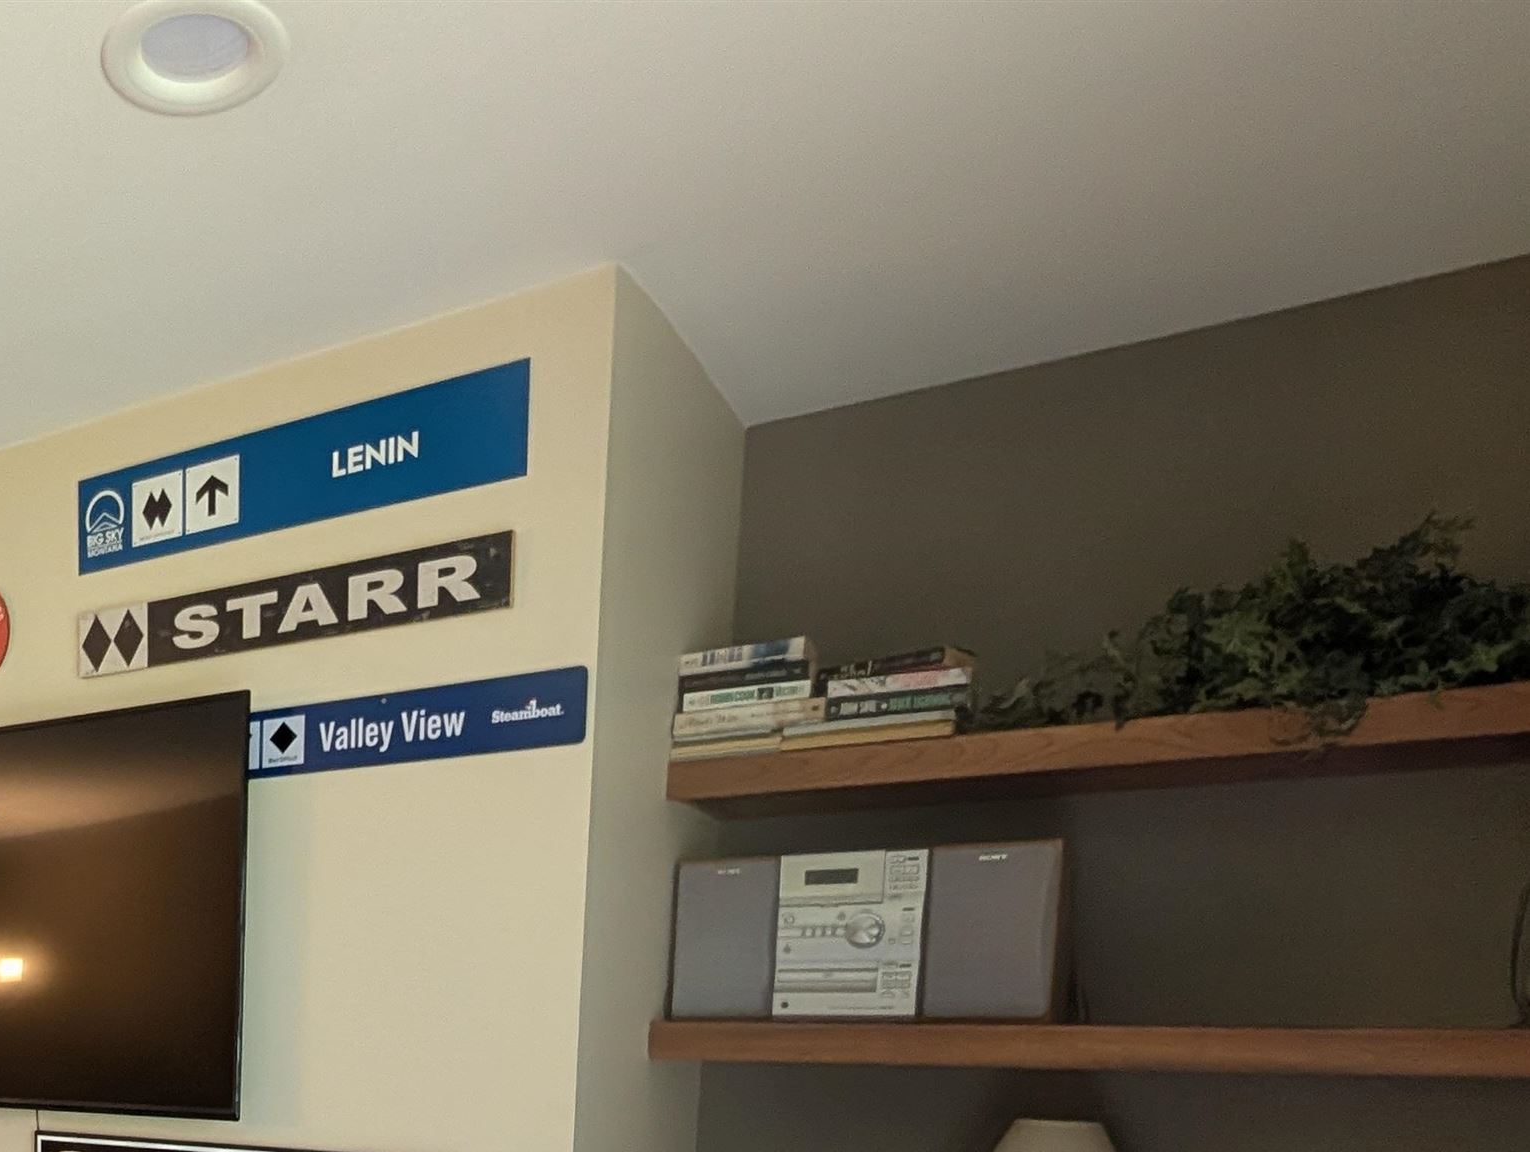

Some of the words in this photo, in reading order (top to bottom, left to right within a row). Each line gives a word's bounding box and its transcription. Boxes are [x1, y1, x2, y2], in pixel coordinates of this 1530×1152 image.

[331, 431, 420, 478] LENIN
[105, 527, 124, 544] SKY
[171, 554, 481, 650] STARR
[319, 717, 394, 752] Valley
[401, 709, 465, 742] View
